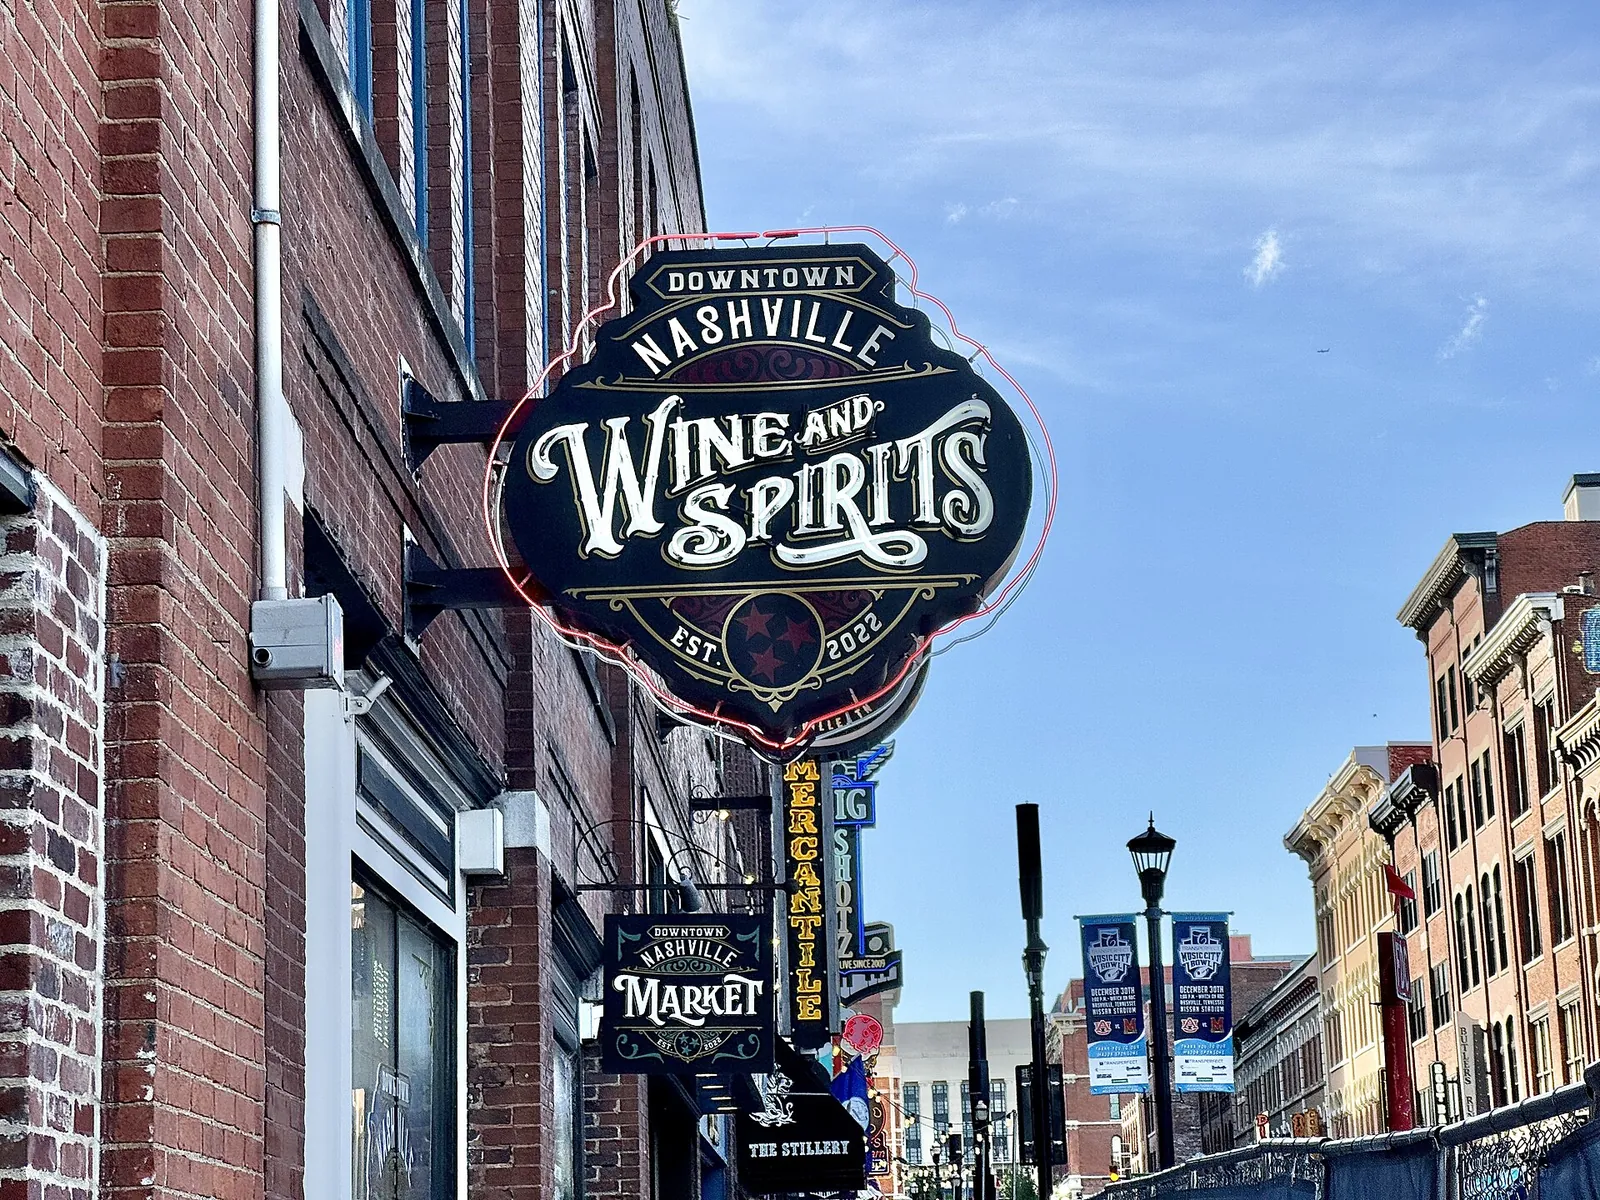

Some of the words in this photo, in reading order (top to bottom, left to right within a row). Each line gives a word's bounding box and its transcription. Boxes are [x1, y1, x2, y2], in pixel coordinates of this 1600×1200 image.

[667, 265, 855, 293] DOWNTOWN
[631, 298, 897, 376] NASHVILLE
[530, 394, 793, 556] WINE
[794, 396, 886, 446] AND
[667, 399, 994, 568] SPIRITS
[670, 624, 722, 667] EST.
[825, 612, 883, 660] 2022
[834, 788, 867, 820] IG
[784, 760, 822, 1020] MERCANTILE
[834, 829, 853, 959] SHOTZ
[654, 928, 724, 936] DOWNTOWN
[640, 939, 738, 968] NASHVILLE
[853, 959, 871, 969] SINCE
[871, 959, 886, 968] 2009
[1091, 954, 1113, 965] MUSIC
[1113, 953, 1130, 964] CITY
[1181, 952, 1203, 962] MUSIC
[1204, 952, 1221, 961] CITY
[613, 973, 764, 1027] MARKET
[1091, 987, 1119, 996] DECEMBER
[1120, 986, 1136, 995] 30TH
[1180, 986, 1208, 994] DECEMBER
[1209, 985, 1224, 993] 30TH
[1113, 1007, 1137, 1015] STADIUM
[656, 1038, 673, 1052] EST.
[703, 1037, 722, 1050] 2022
[1460, 1027, 1471, 1085] BUTLERS
[1433, 1063, 1446, 1102] BOOT
[1437, 1104, 1447, 1124] BA
[749, 1143, 777, 1158] THE
[781, 1140, 850, 1157] STILLERY
